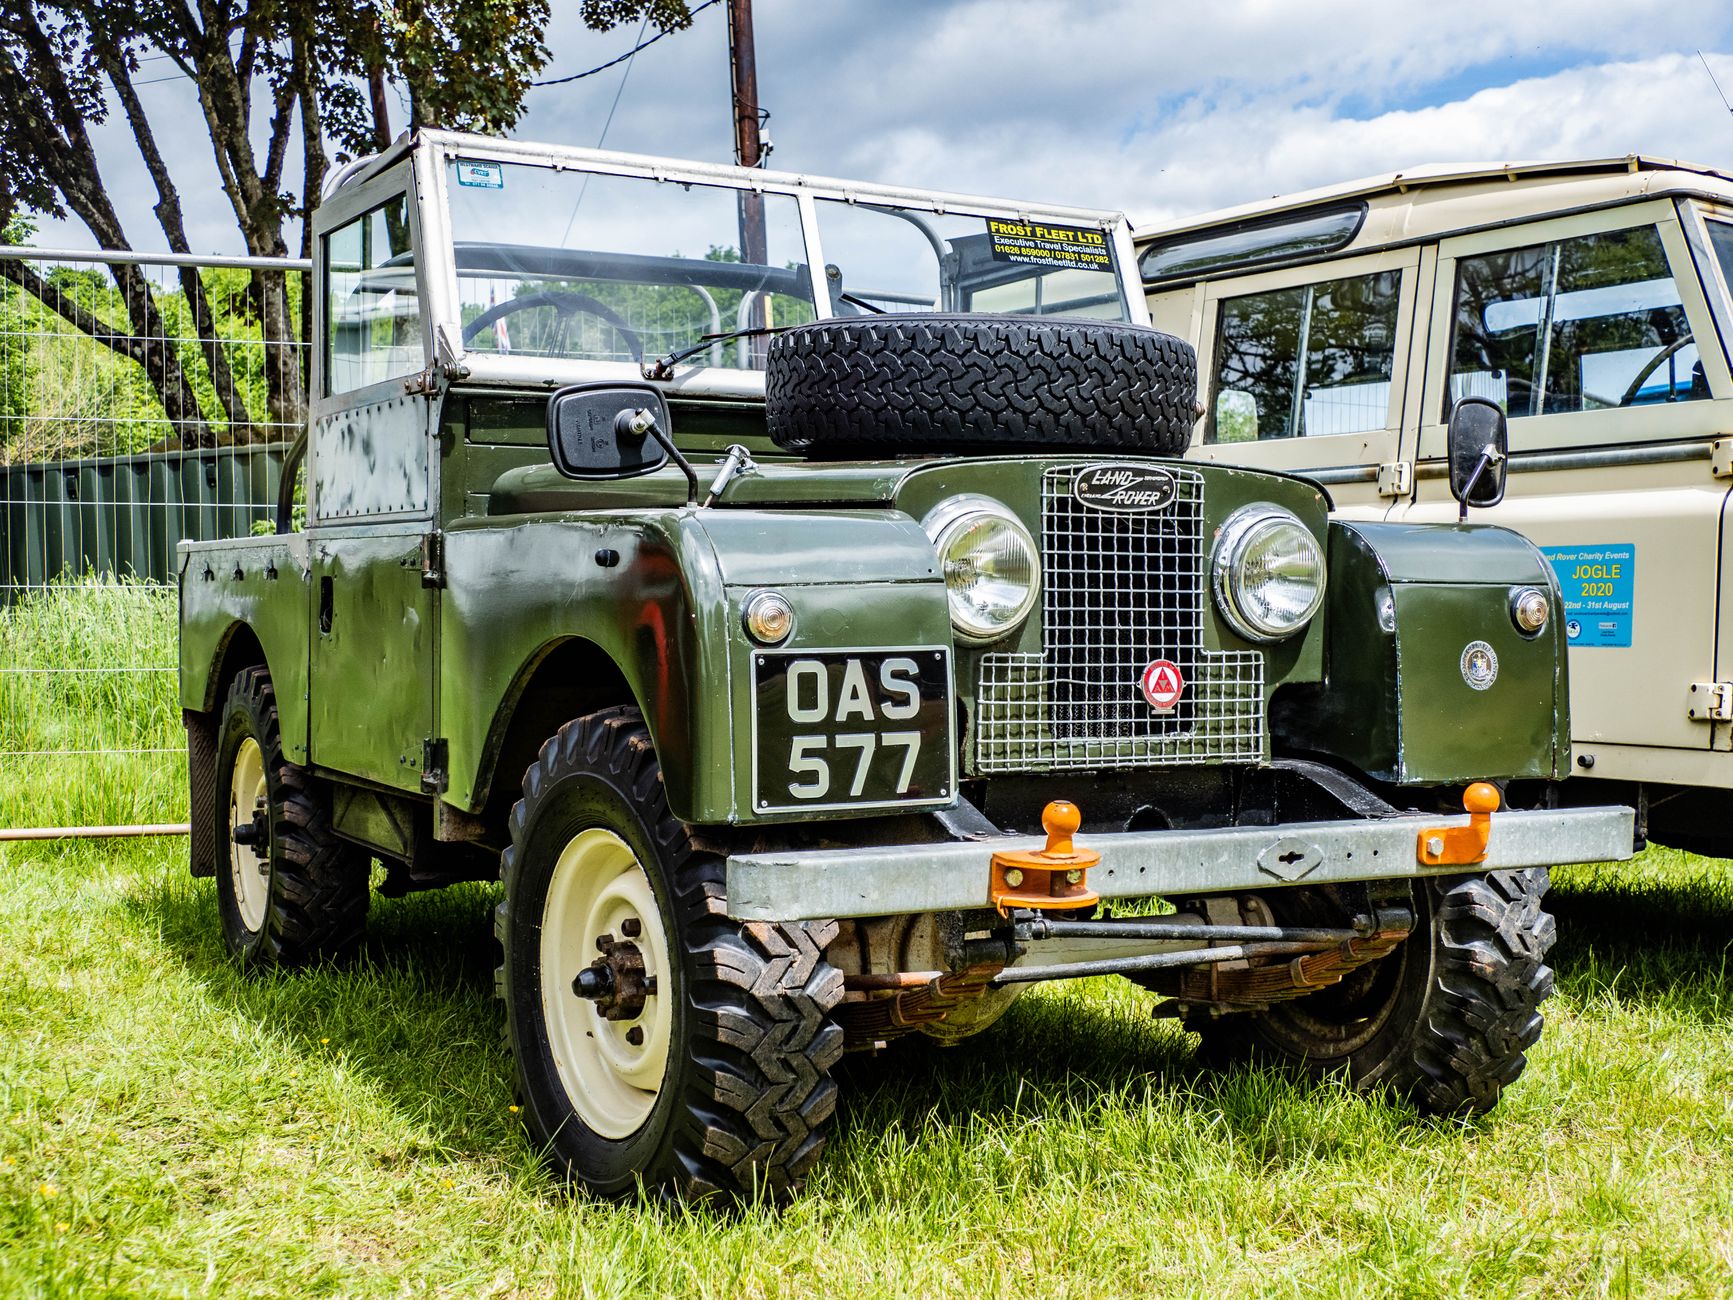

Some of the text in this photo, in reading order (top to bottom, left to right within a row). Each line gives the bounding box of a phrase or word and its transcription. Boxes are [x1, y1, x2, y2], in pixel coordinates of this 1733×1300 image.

[990, 222, 1106, 245] FROST FLEET LTD.
[994, 236, 1106, 255] Executive Travel Specialists
[995, 245, 1020, 254] 01626
[1021, 248, 1050, 257] 859000
[1055, 251, 1079, 261] 07831
[1081, 254, 1109, 264] 501282
[1009, 255, 1099, 269] www.frostfleetltd.co.uk
[1091, 470, 1133, 485] LAND
[1112, 490, 1160, 505] ROVER
[1556, 553, 1577, 561] Rover
[1578, 552, 1603, 561] Charity
[1605, 551, 1629, 559] Events
[1572, 564, 1621, 579] JOGLE
[1581, 582, 1613, 596] 2020
[1564, 601, 1581, 609] 22nd
[1587, 601, 1602, 609] 31st
[1603, 601, 1629, 610] August
[787, 657, 920, 723] OAS
[788, 731, 921, 799] 577
